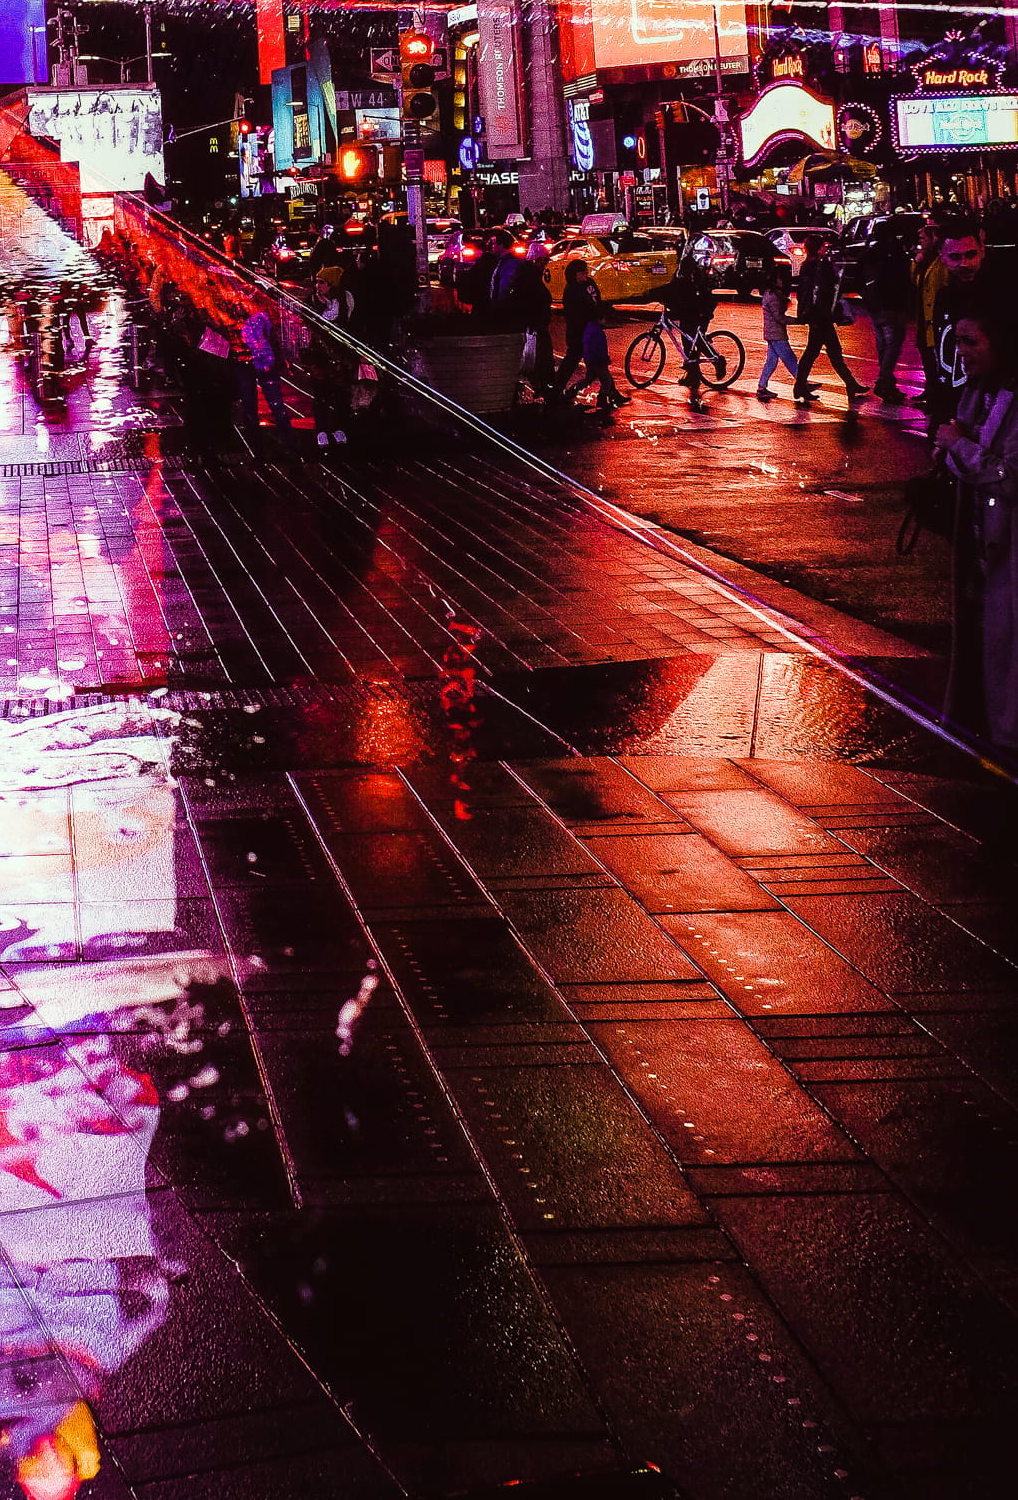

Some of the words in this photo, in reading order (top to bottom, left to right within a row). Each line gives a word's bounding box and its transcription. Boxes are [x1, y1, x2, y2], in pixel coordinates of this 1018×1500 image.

[495, 62, 506, 110] THOMSON
[925, 70, 957, 85] Hard
[958, 69, 989, 86] Rock
[351, 93, 362, 108] W
[368, 92, 384, 106] 44
